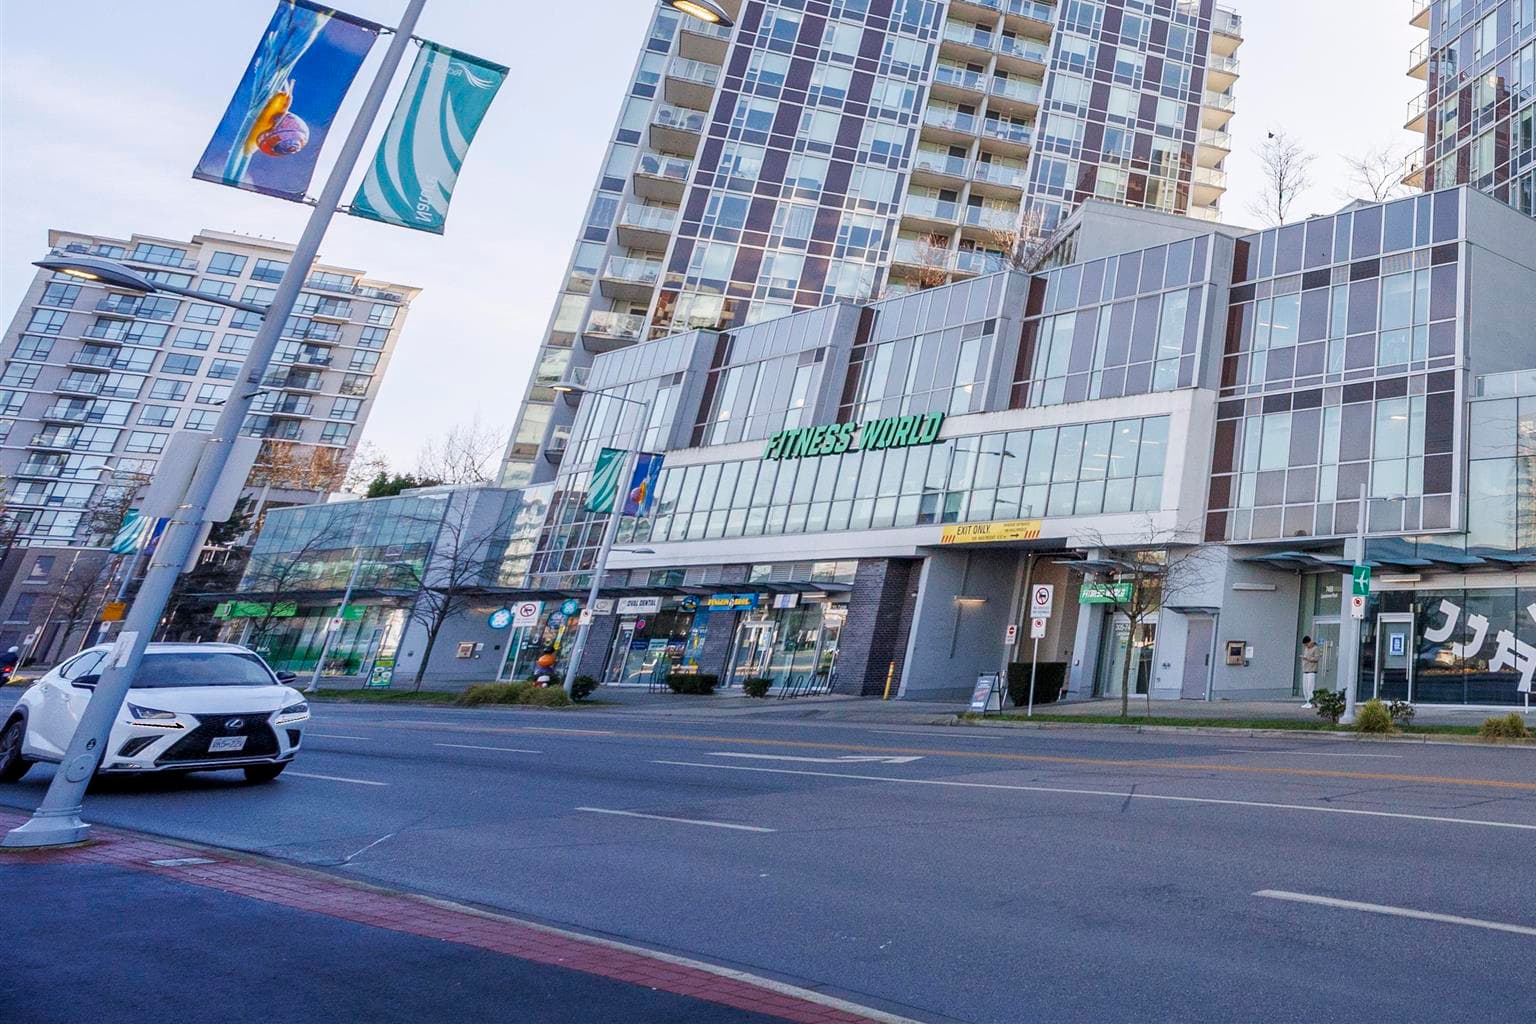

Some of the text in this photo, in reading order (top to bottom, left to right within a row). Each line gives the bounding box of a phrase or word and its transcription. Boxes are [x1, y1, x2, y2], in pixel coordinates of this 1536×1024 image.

[763, 411, 946, 461] FITNESS WORLD
[957, 524, 991, 535] EXIT ONLY
